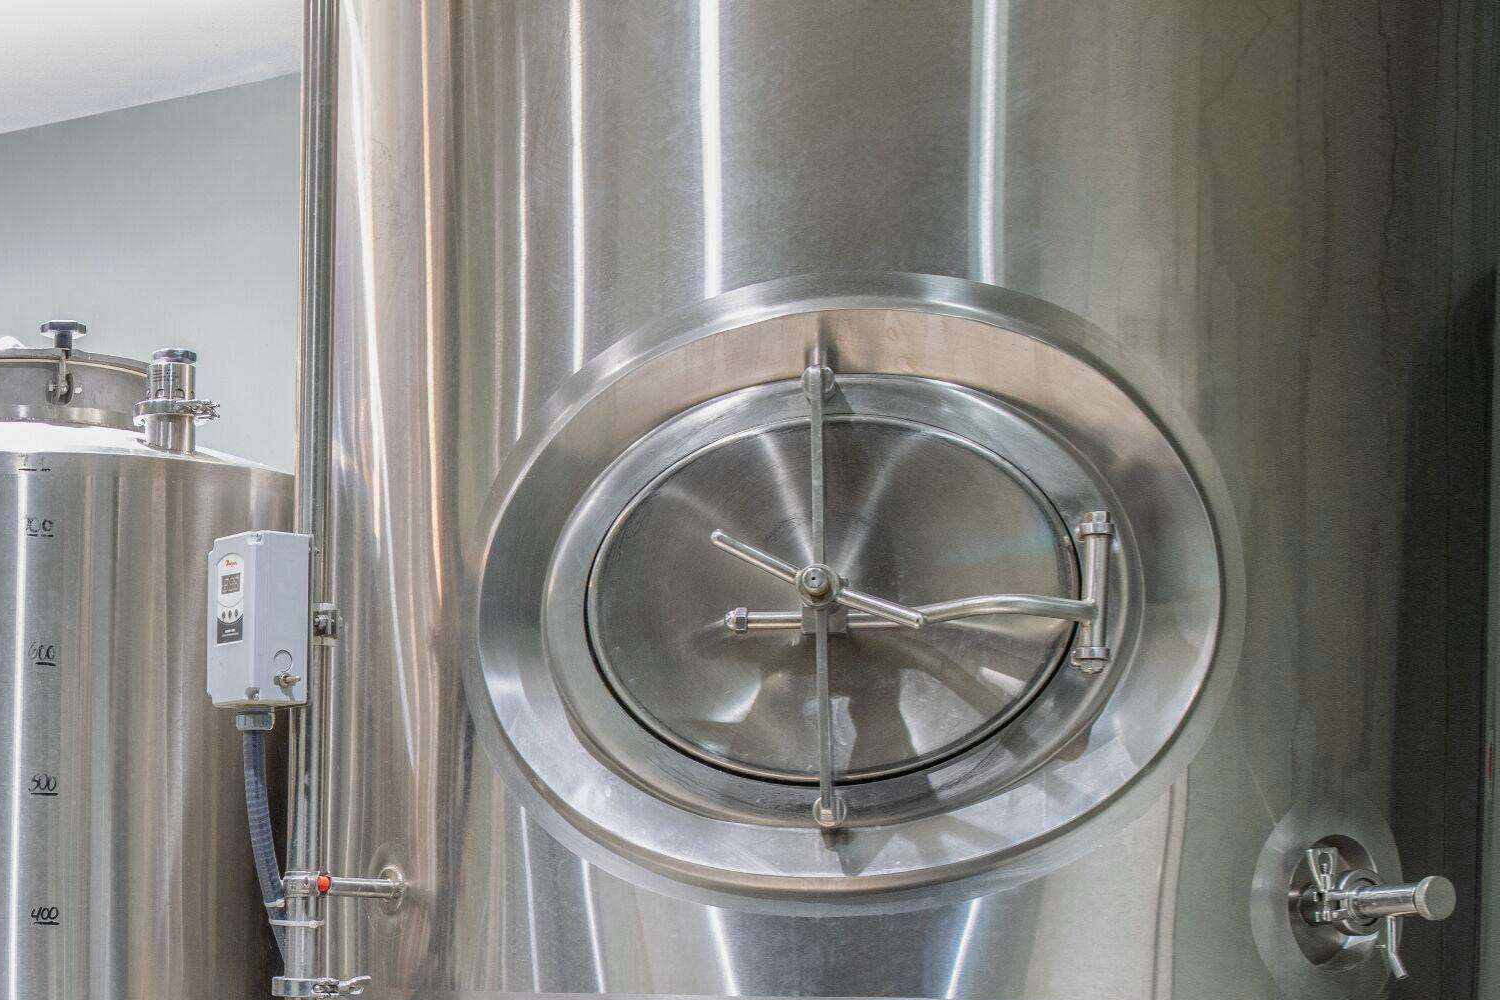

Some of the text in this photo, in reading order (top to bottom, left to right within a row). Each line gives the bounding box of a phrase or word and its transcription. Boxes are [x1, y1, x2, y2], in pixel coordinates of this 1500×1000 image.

[27, 641, 54, 660] 600
[29, 773, 57, 791] 500
[31, 906, 59, 920] 400
